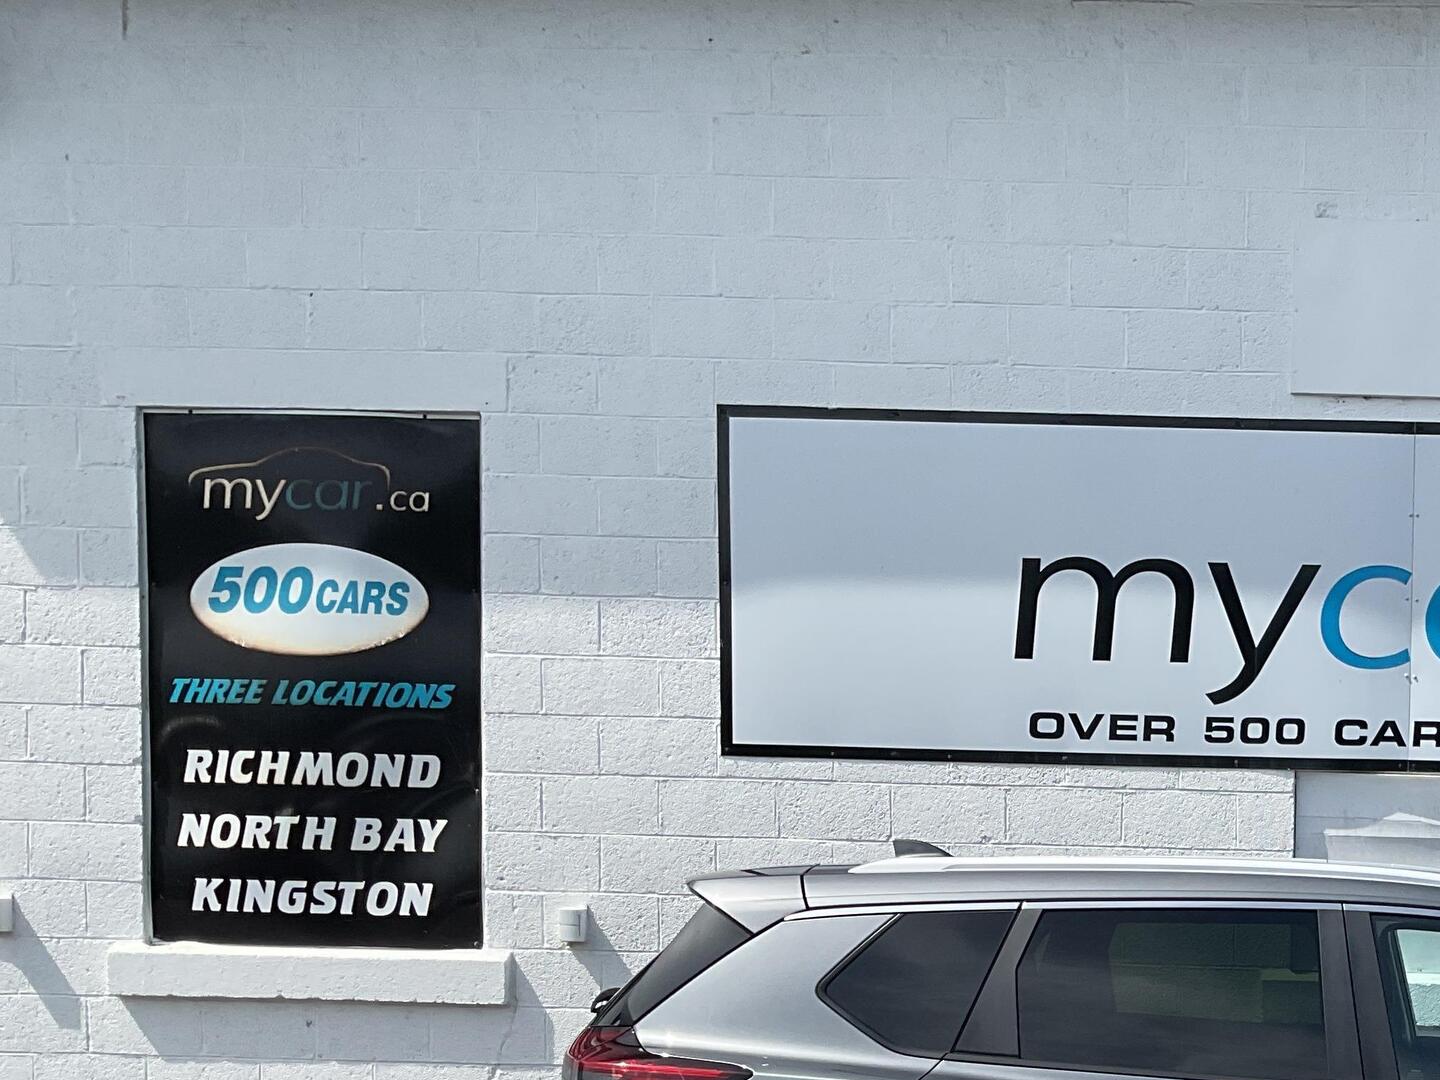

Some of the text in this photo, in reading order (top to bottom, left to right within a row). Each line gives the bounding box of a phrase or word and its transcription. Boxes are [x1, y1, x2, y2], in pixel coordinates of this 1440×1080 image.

[203, 474, 430, 520] mycar.ca
[208, 565, 410, 616] 500 CARS
[169, 677, 456, 709] THREE LOCATIONS
[1028, 710, 1176, 743] OVER
[1204, 716, 1307, 746] 500
[183, 749, 441, 789] RICHMOND
[177, 812, 448, 853] NORTH BAY
[191, 877, 433, 917] KINGSTON
